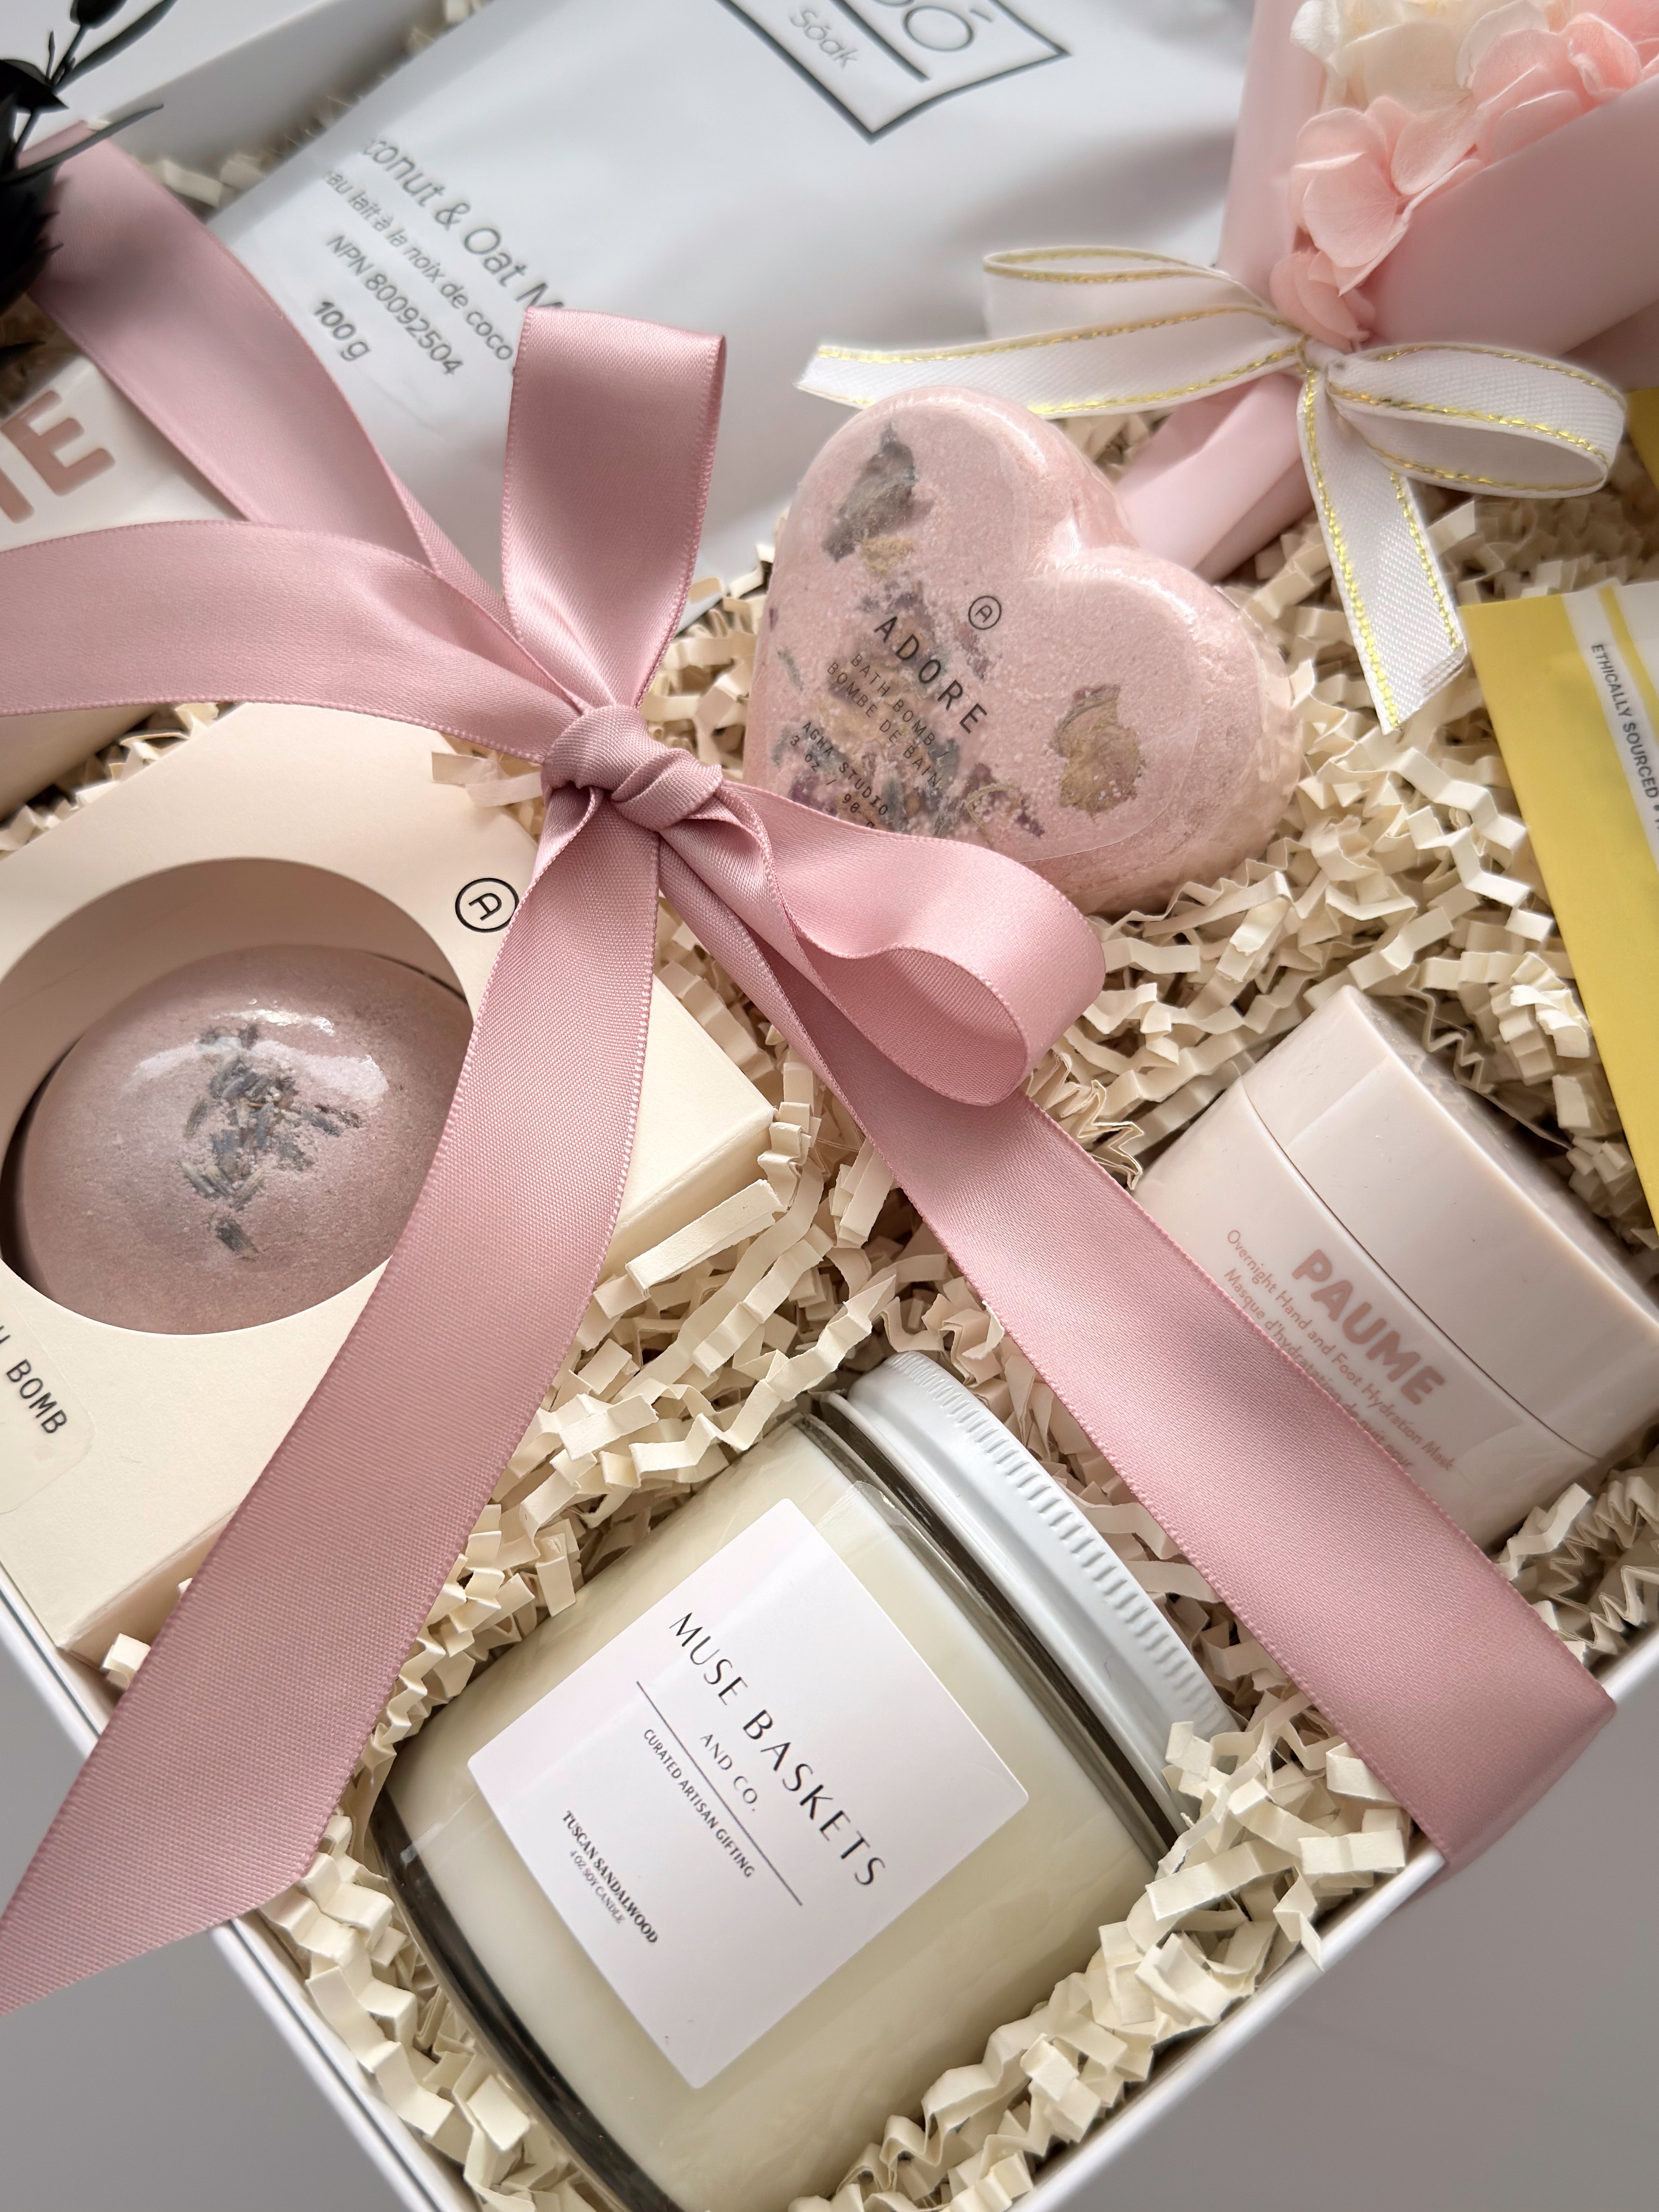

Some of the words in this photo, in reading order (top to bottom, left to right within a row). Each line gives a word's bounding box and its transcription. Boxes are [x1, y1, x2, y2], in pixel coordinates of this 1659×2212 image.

[347, 192, 382, 221] lait
[386, 229, 409, 247] la
[403, 246, 447, 284] noix
[441, 283, 469, 309] de
[466, 310, 513, 360] coco
[435, 203, 471, 230] &
[464, 227, 526, 287] Oat
[313, 300, 356, 341] 100
[340, 341, 371, 362] g
[326, 235, 374, 276] NPN
[366, 272, 464, 375] 80092504
[827, 662, 878, 718] BOMBE
[879, 720, 900, 744] DE
[903, 747, 943, 787] BAIN
[851, 654, 891, 697] BATH
[893, 699, 935, 746] BOMB
[874, 616, 988, 734] ADORE
[1591, 644, 1632, 717] ETHICALLY
[1622, 722, 1659, 798] SOURCED
[790, 735, 800, 746] 3
[842, 794, 860, 813] 90
[803, 722, 833, 757] AGHA
[839, 762, 888, 815] STUDIO
[1224, 1268, 1265, 1320] Masque
[1227, 1230, 1276, 1294] Overnight
[1275, 1290, 1312, 1331] Hand
[1308, 1331, 1336, 1355] and
[1331, 1352, 1363, 1386] Foot
[1361, 1383, 1423, 1445] Hydration
[1422, 1440, 1455, 1471] Mask
[1291, 1249, 1447, 1405] PAUME
[6, 1359, 67, 1433] BOMB
[643, 1729, 682, 1779] CURATED
[678, 1779, 718, 1829] ARTISAN
[715, 1829, 755, 1878] GIFTING
[669, 1612, 748, 1705] MUSE
[743, 1709, 886, 1886] BASKETS
[700, 1734, 733, 1771] AND
[734, 1775, 758, 1811] CO.
[563, 1810, 598, 1859] TUSCAN
[594, 1858, 658, 1943] SANDALWOOD
[583, 1869, 598, 1886] SOY
[596, 1886, 625, 1924] CANDLE
